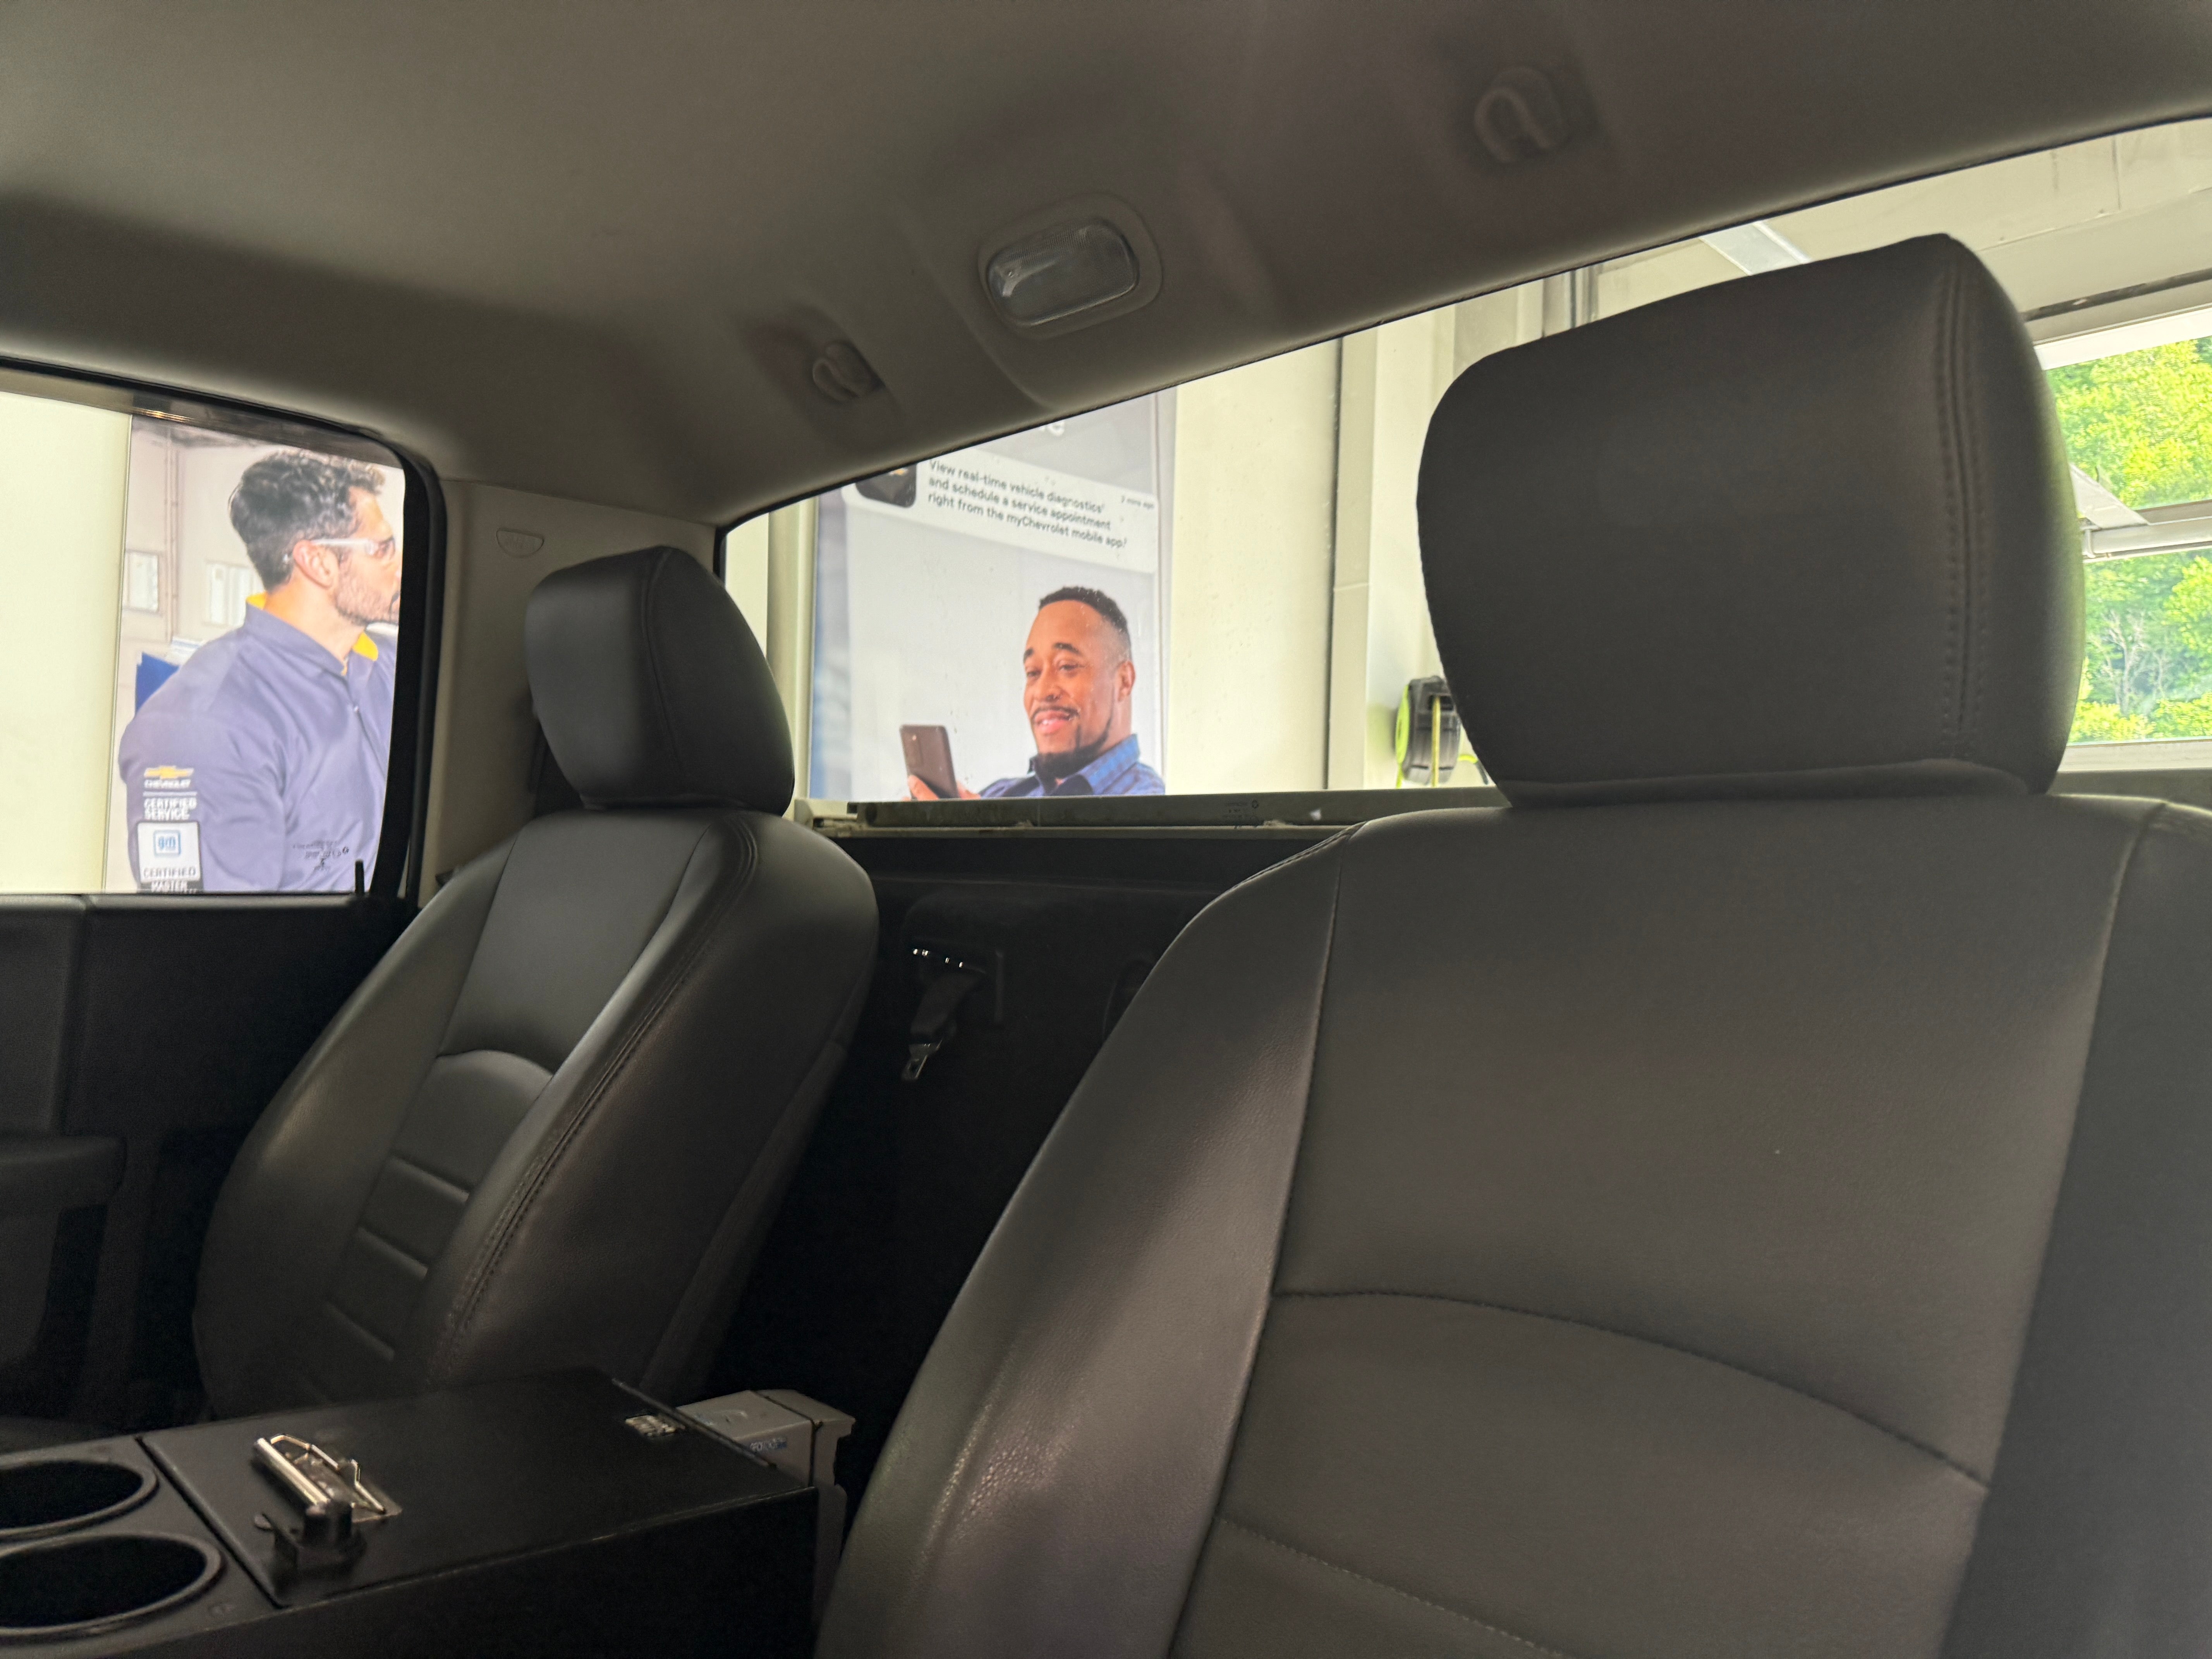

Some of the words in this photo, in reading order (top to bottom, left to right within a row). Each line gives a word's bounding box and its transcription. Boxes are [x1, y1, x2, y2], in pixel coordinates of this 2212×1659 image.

[930, 460, 956, 476] View
[958, 469, 1007, 490] real-time
[1009, 484, 1044, 500] vehicle
[929, 478, 949, 490] and
[952, 484, 1000, 504] schedule
[1003, 497, 1009, 506] a
[1012, 500, 1048, 516] service
[1051, 510, 1111, 531] appointment
[928, 492, 954, 508] right
[958, 498, 984, 516] from
[987, 507, 1004, 520] the
[1007, 514, 1069, 537] myChevrolet
[1071, 529, 1103, 544] mobile
[144, 798, 197, 809] CERTIFIED
[144, 808, 190, 821] SERVICE
[143, 866, 196, 878] CERTIFIED
